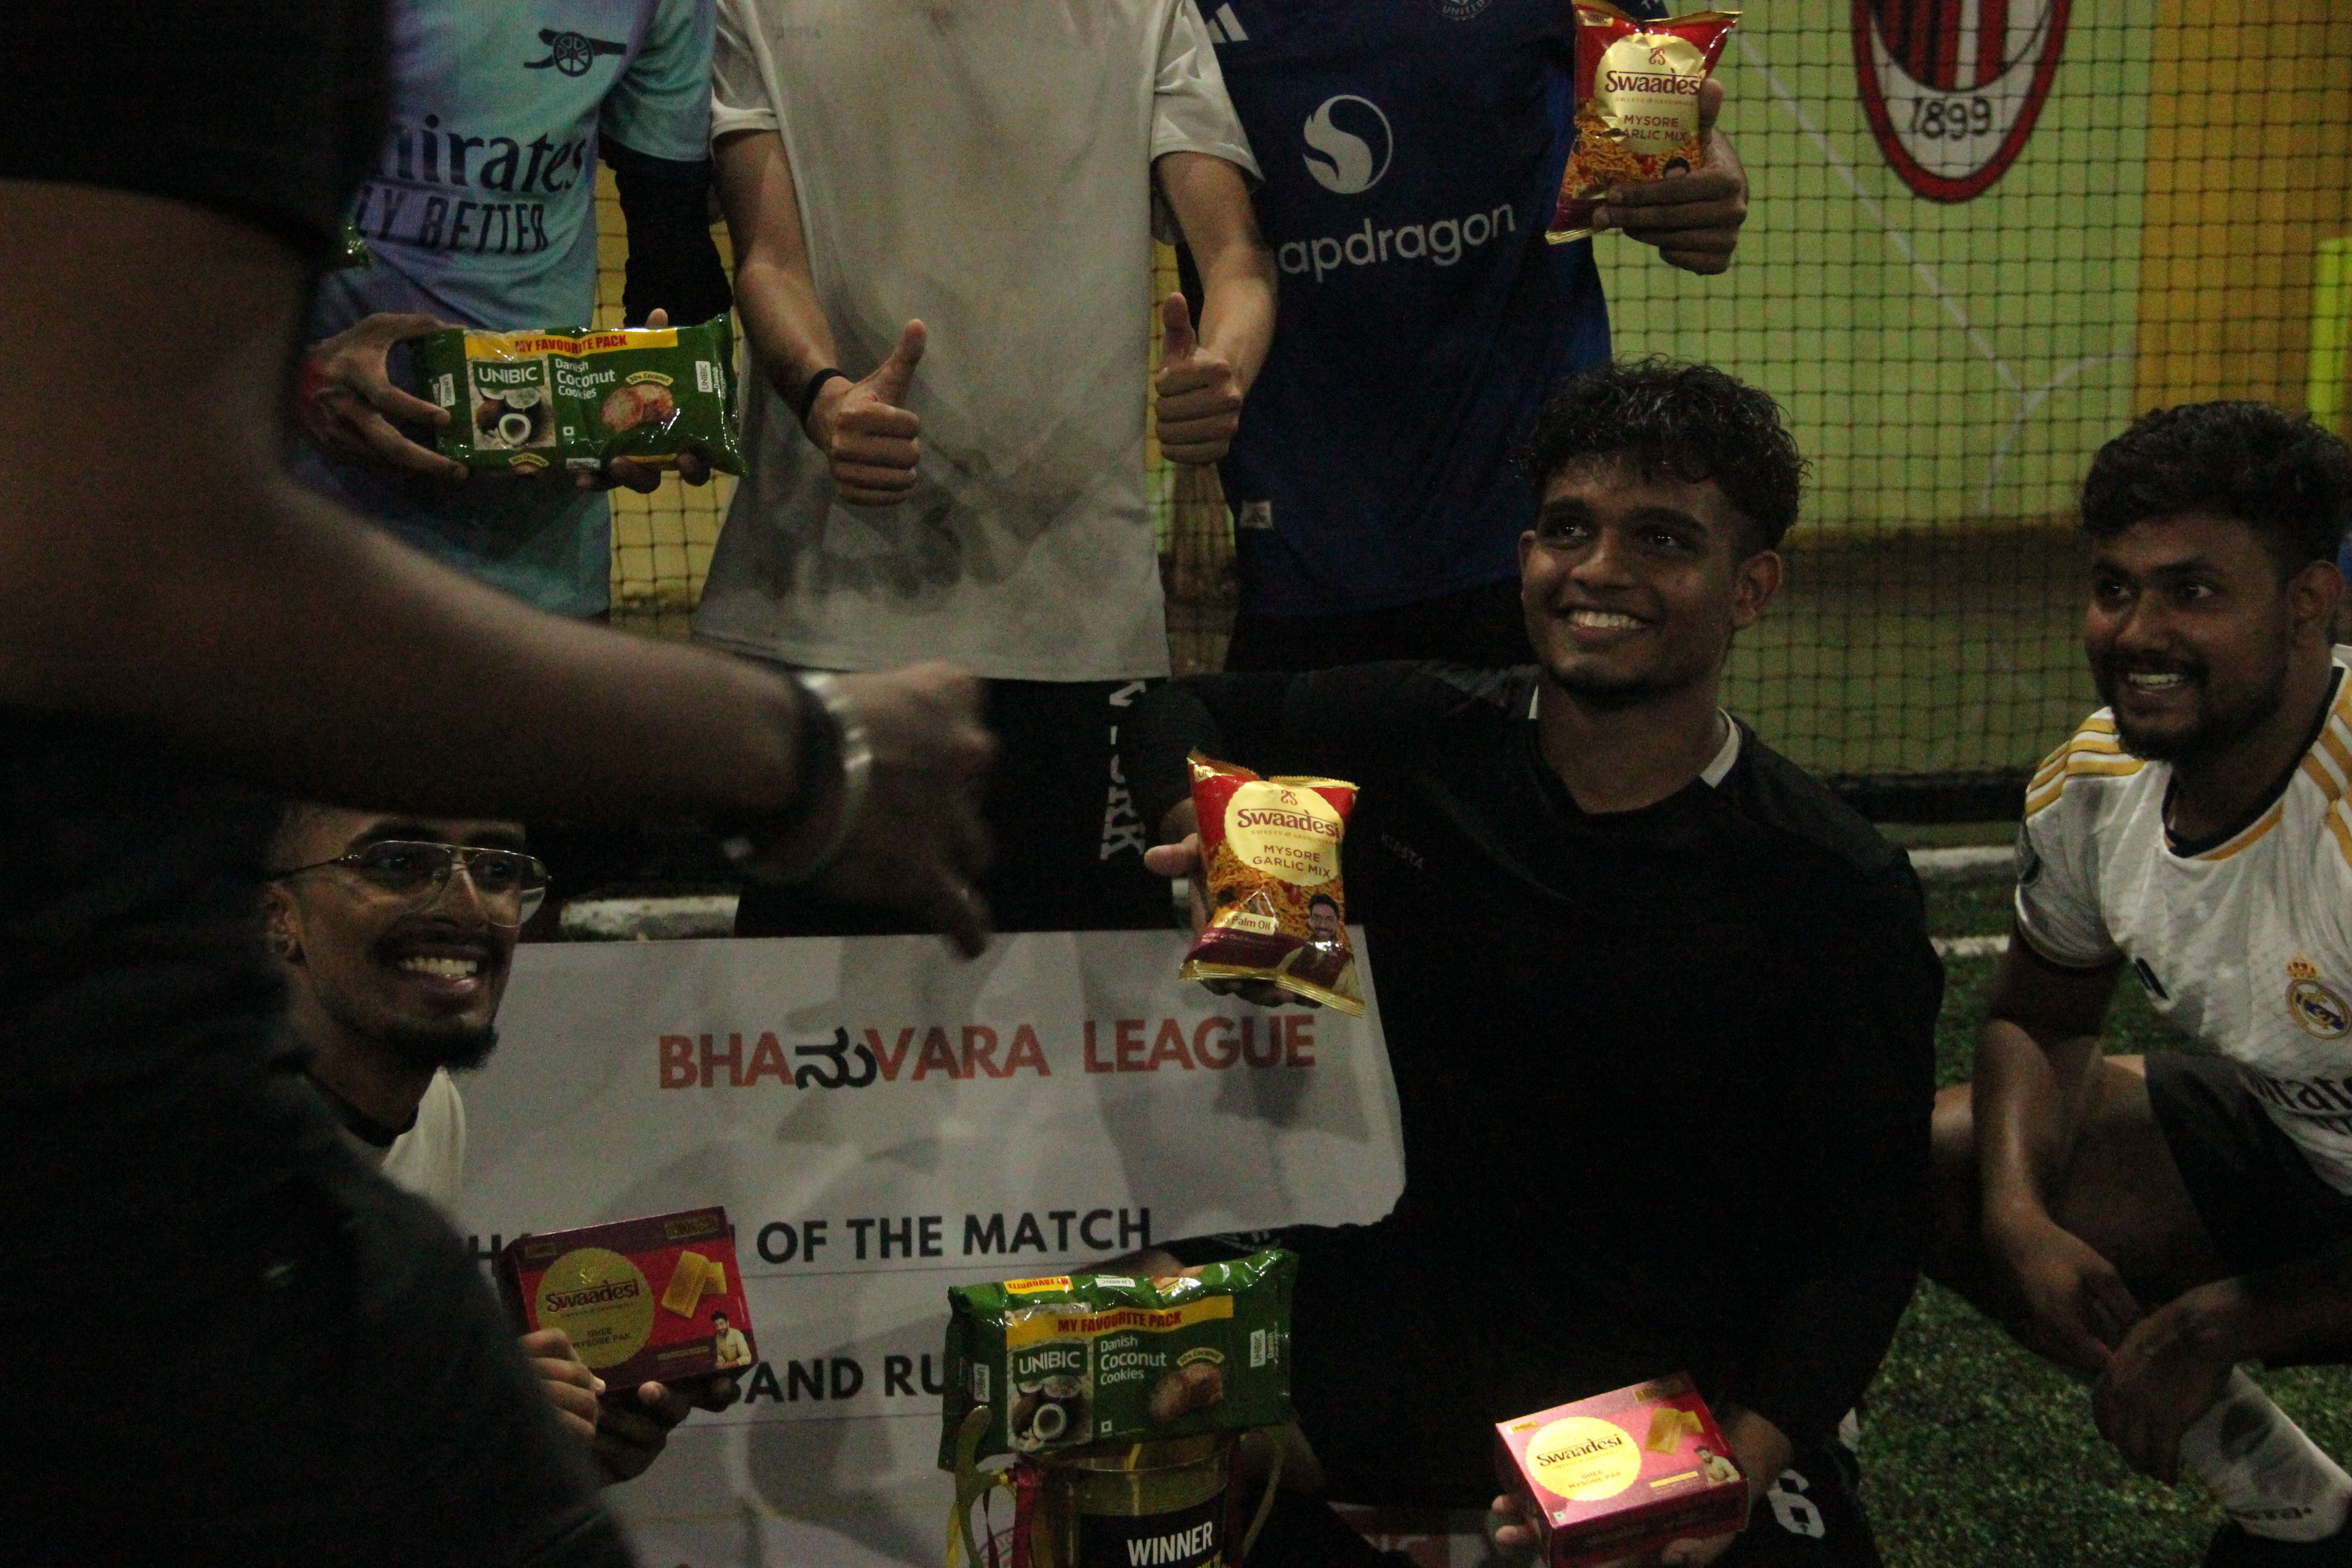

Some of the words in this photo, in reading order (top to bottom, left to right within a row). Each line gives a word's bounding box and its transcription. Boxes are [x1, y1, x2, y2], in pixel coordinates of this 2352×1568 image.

[1624, 115, 1679, 127] MYSORE
[1910, 96, 1991, 140] 1899
[1665, 131, 1687, 142] MIX
[416, 196, 547, 253] BETTER
[535, 338, 593, 354] FAVOURITE
[596, 335, 627, 348] PACK
[555, 358, 589, 372] Danish
[478, 367, 538, 384] UNIBIC
[556, 370, 616, 388] Coconut
[558, 386, 597, 399] Cookies
[1237, 808, 1339, 838] Swaadesi
[1264, 845, 1320, 862] MYSORE
[1253, 856, 1303, 872] GARLIC
[1308, 865, 1330, 878] MIX
[1231, 916, 1255, 928] Palm
[1257, 920, 1270, 931] Oil
[1084, 1014, 1315, 1073] LEAGUE
[754, 1221, 827, 1263] OF
[846, 1216, 942, 1259] THE
[960, 1208, 1150, 1254] MATCH
[546, 1279, 639, 1312] Swaadesi
[1058, 1318, 1077, 1332] MY
[1081, 1314, 1145, 1332] FAVOURITE
[1149, 1311, 1181, 1328] PACK
[1100, 1338, 1138, 1353] Danish
[1019, 1351, 1080, 1374] UNIBIC
[1100, 1351, 1167, 1371] Coconut
[1100, 1368, 1145, 1385] Cookies
[1536, 1433, 1623, 1467] Swaadesi
[1127, 1520, 1213, 1567] WINNER
